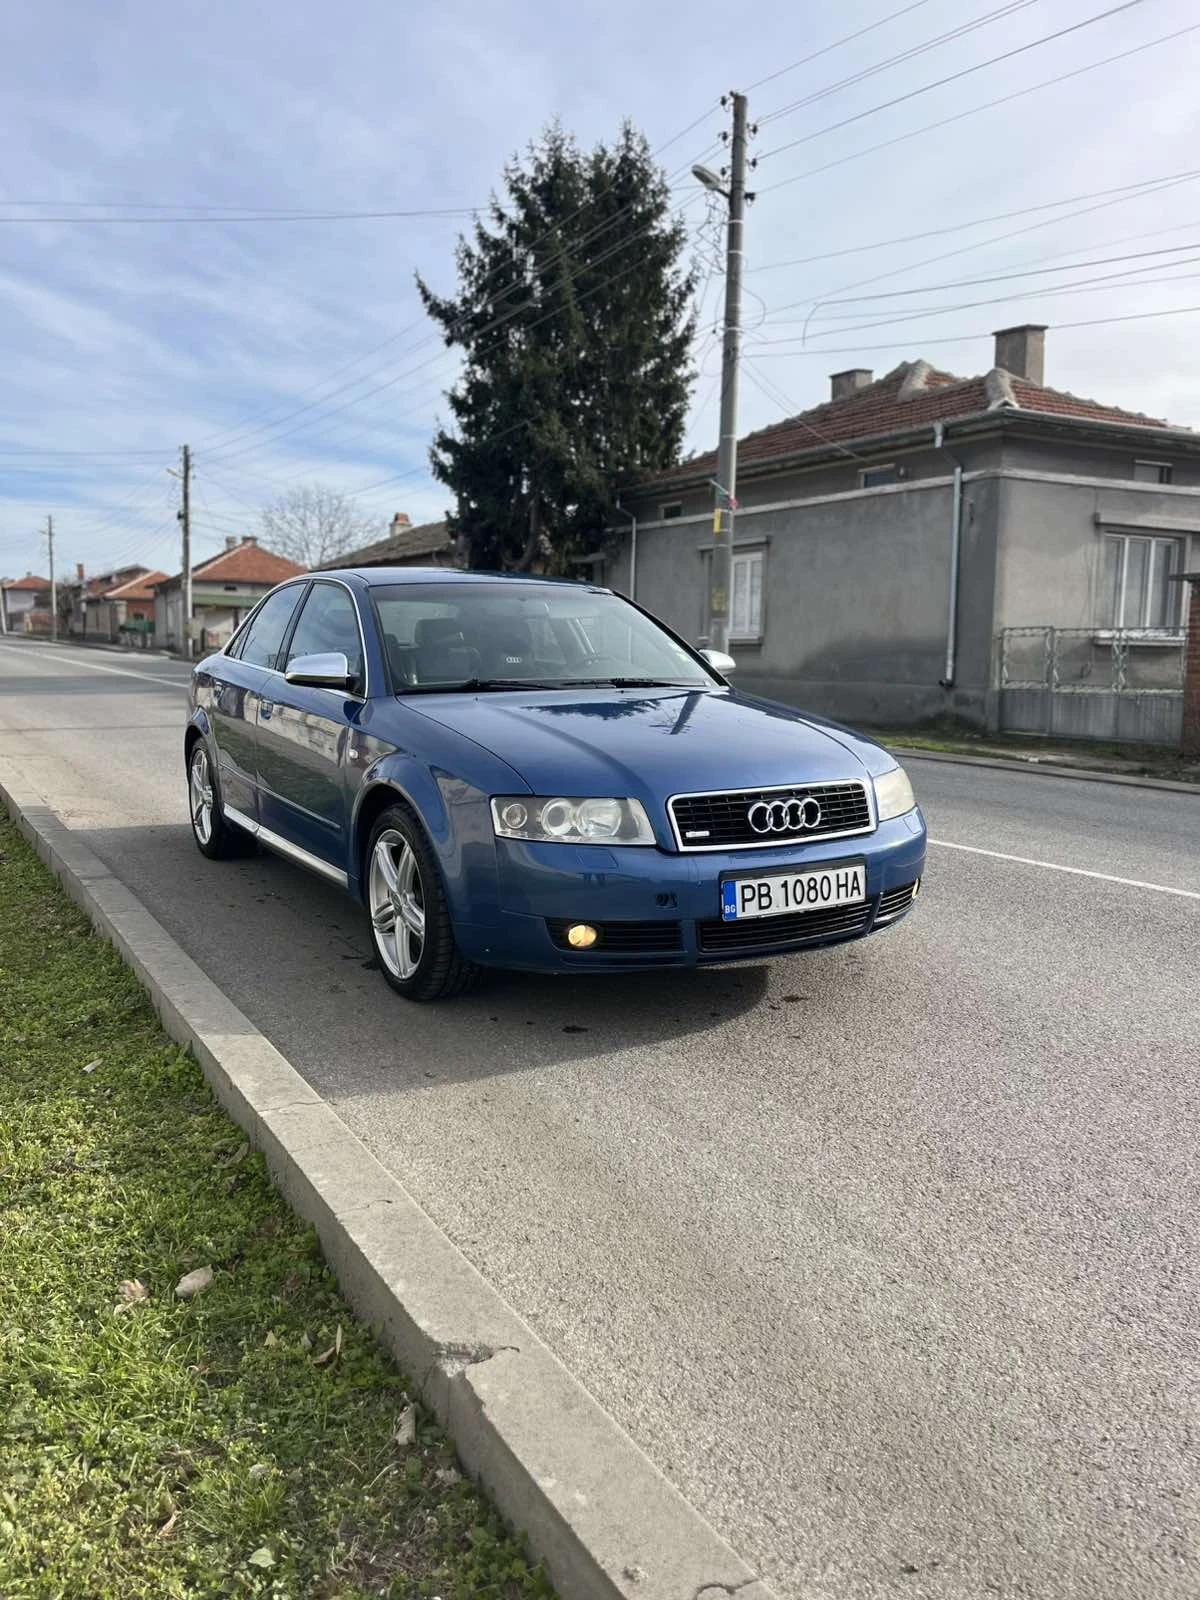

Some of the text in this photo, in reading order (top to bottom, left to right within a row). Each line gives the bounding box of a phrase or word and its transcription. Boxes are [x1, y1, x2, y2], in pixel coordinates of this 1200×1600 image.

[741, 871, 861, 913] PB 1080 HA
[725, 905, 736, 914] BG
